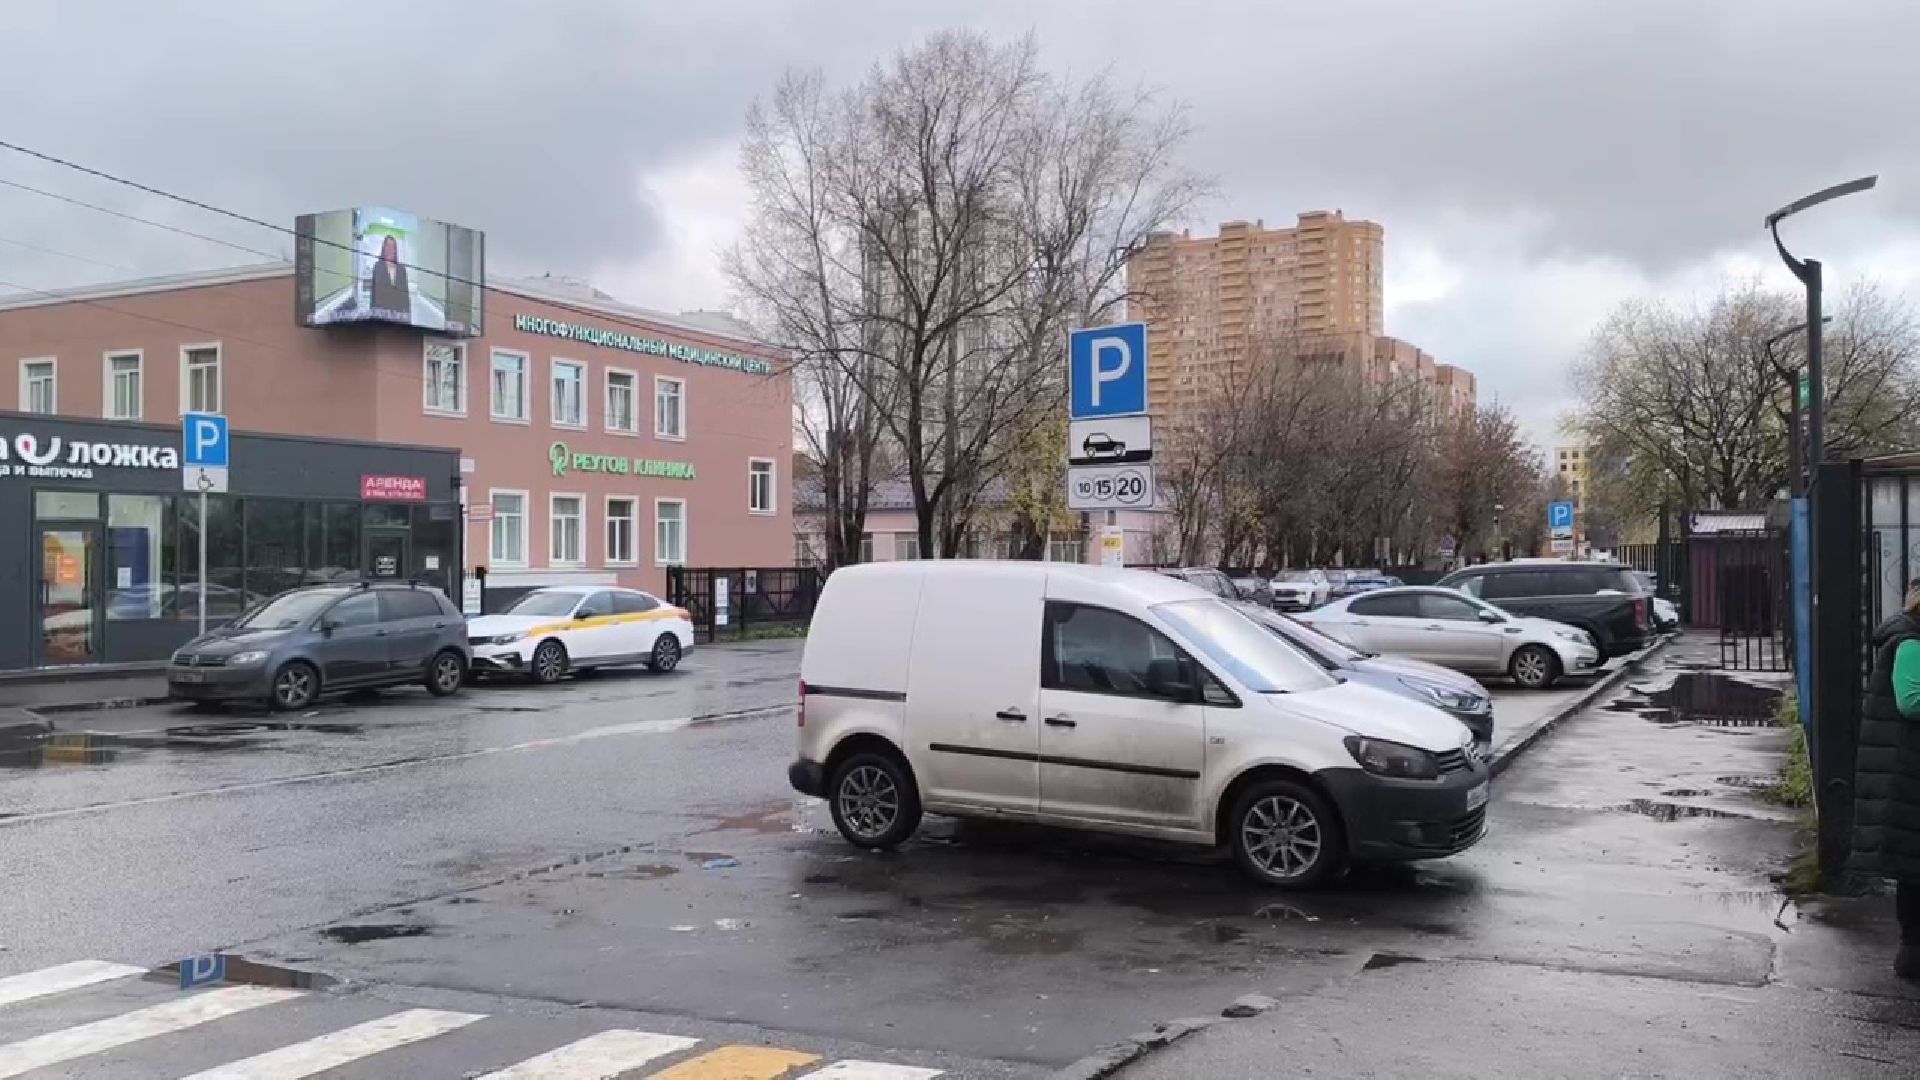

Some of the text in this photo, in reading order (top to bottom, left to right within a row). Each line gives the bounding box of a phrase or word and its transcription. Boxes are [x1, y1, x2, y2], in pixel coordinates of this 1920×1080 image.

[515, 313, 667, 356] МНОГОФУНКЦИОНАЛЬНЫЙ
[1092, 337, 1130, 407] P
[196, 420, 219, 460] P
[68, 441, 179, 469] ложка
[572, 452, 697, 480] РЕУТОВ КЛИНИКА
[28, 466, 94, 479] выпечка
[366, 477, 421, 491] АРЕНДА
[1079, 477, 1142, 495] 10 15 20
[1555, 506, 1568, 526] P
